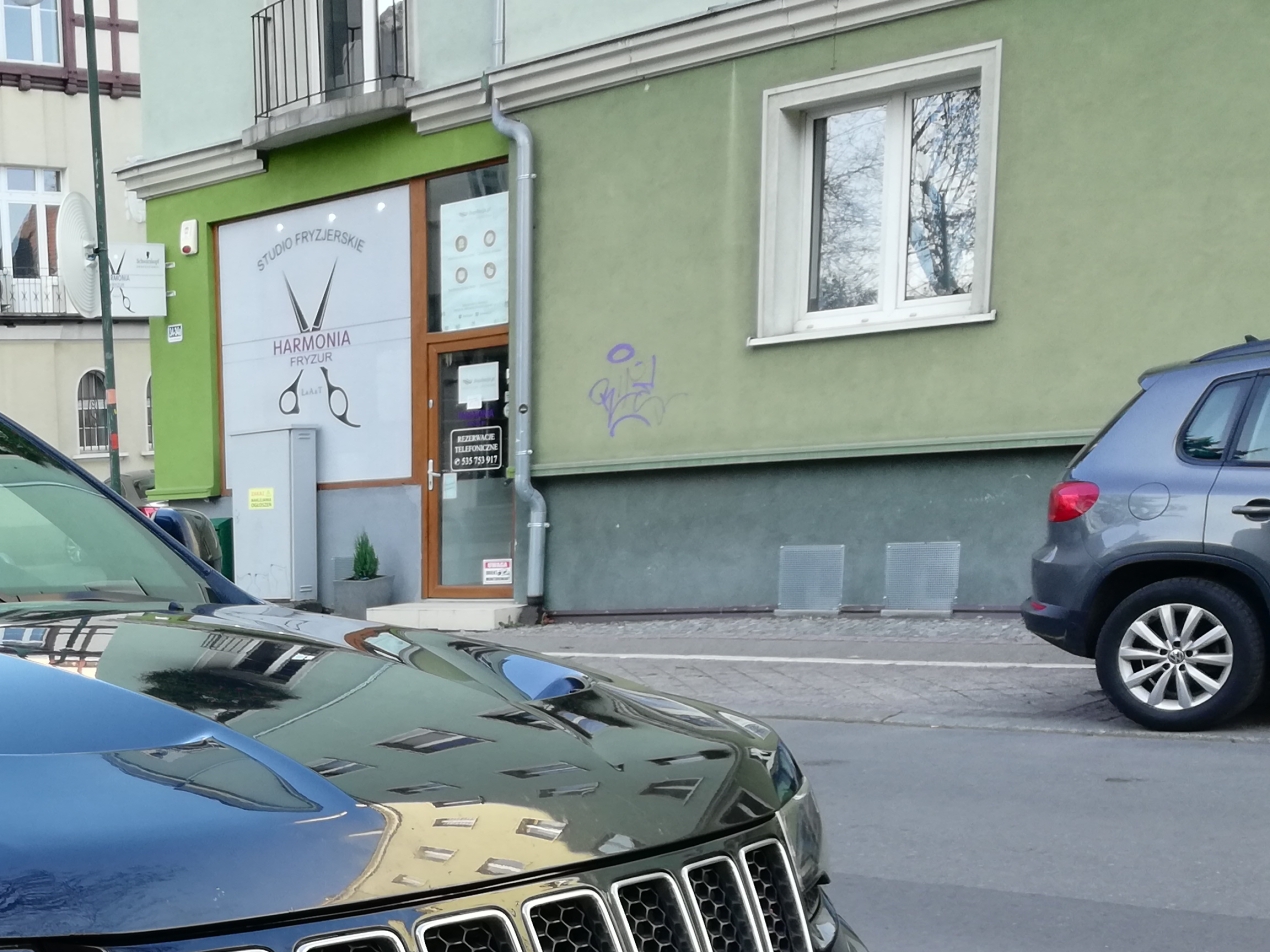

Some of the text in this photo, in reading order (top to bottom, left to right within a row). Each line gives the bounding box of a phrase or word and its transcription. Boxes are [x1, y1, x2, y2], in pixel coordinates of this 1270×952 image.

[257, 229, 365, 271] STUDIO FRYZJERSKIE
[273, 330, 351, 355] HARMONIA
[290, 352, 333, 367] FRYZUR
[454, 443, 499, 453] TELEFONICZNE
[461, 455, 498, 465] 535 753 917
